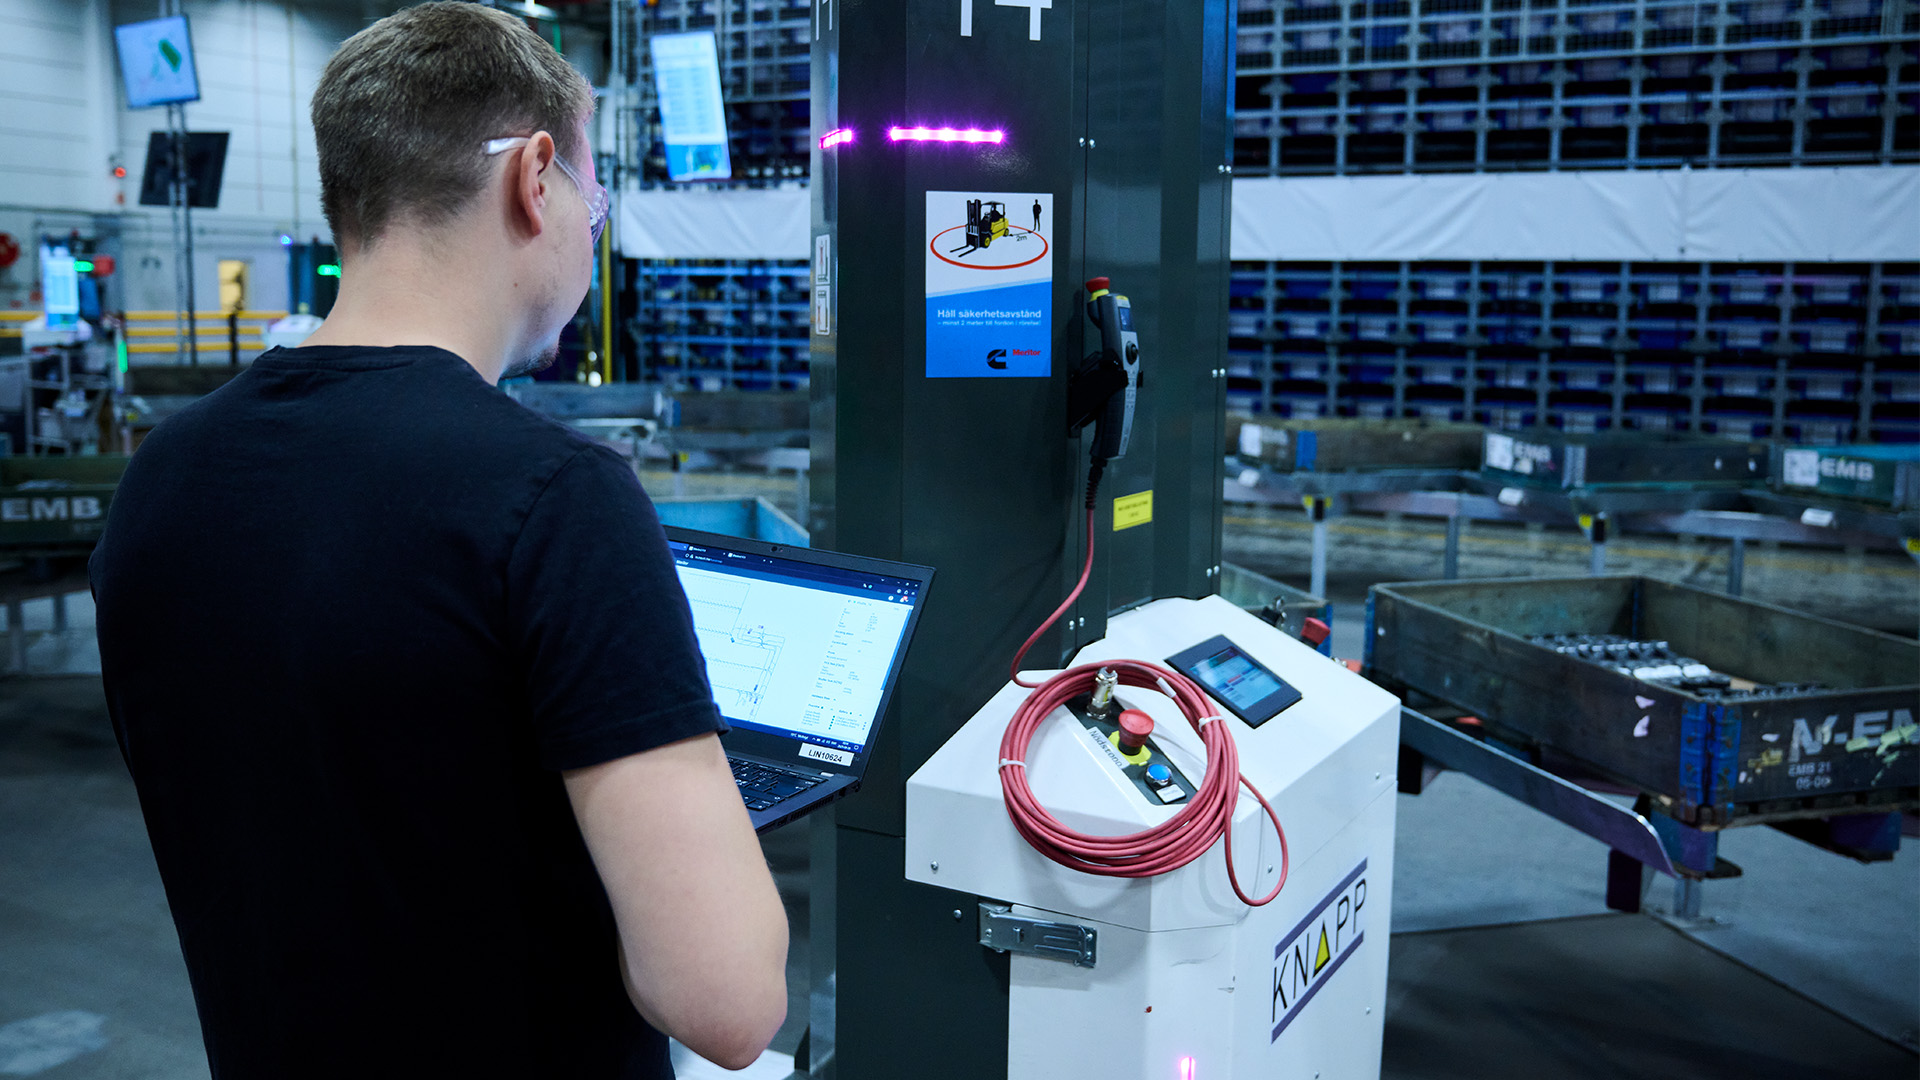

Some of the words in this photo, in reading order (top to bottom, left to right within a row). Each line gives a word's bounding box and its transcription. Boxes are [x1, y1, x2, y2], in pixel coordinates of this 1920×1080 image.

[937, 309, 956, 318] Håll
[958, 309, 1042, 318] säkerhetsavstånd
[1, 497, 101, 521] EMB
[808, 749, 843, 763] LIN10624
[1272, 878, 1367, 1023] KNAPP
